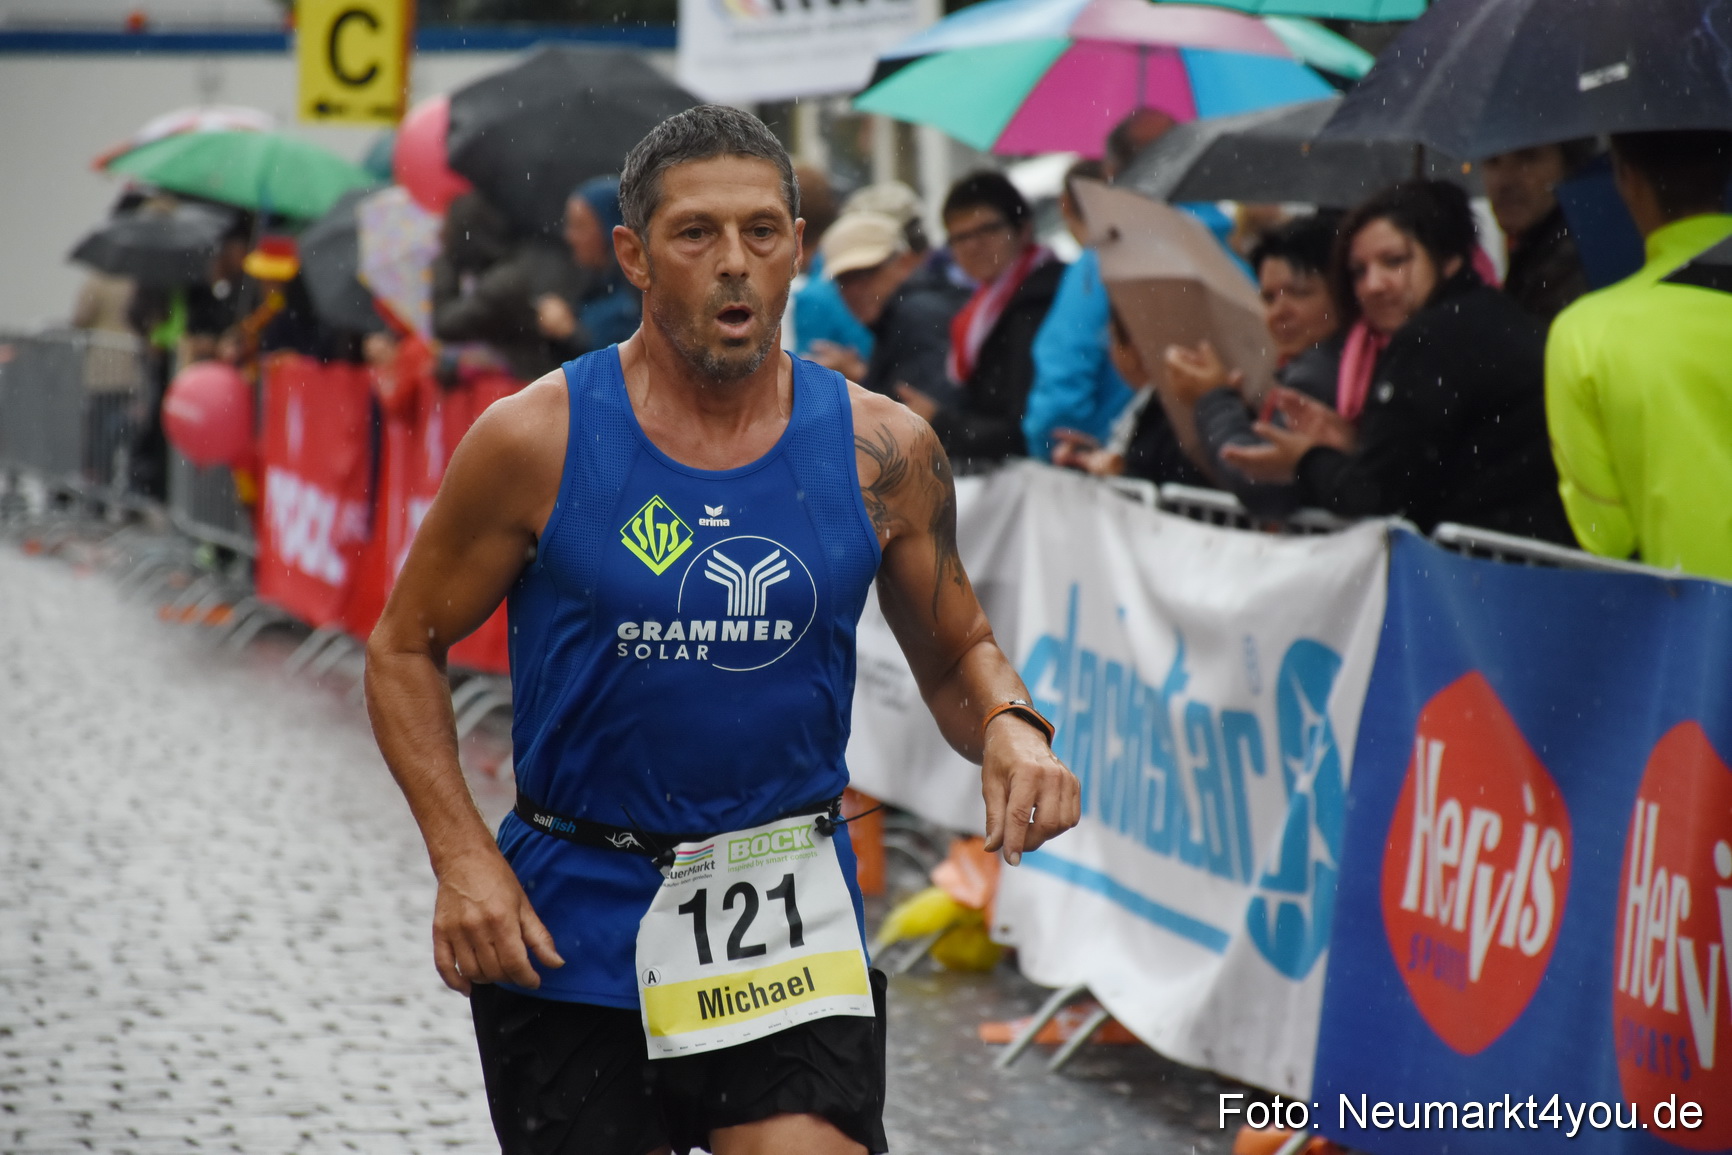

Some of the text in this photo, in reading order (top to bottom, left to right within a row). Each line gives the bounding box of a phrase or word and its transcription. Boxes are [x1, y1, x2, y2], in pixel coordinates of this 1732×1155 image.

[327, 8, 379, 87] C
[631, 499, 680, 562] SGS
[699, 517, 730, 527] erima
[617, 619, 793, 642] GRAMMER
[617, 643, 709, 661] SOLAR
[533, 813, 577, 834] sailfish
[728, 824, 815, 864] BOCK
[755, 859, 764, 868] by
[766, 855, 788, 864] smart
[1401, 735, 1564, 984] Hervis
[678, 873, 805, 965] 121
[697, 966, 815, 1020] Michael
